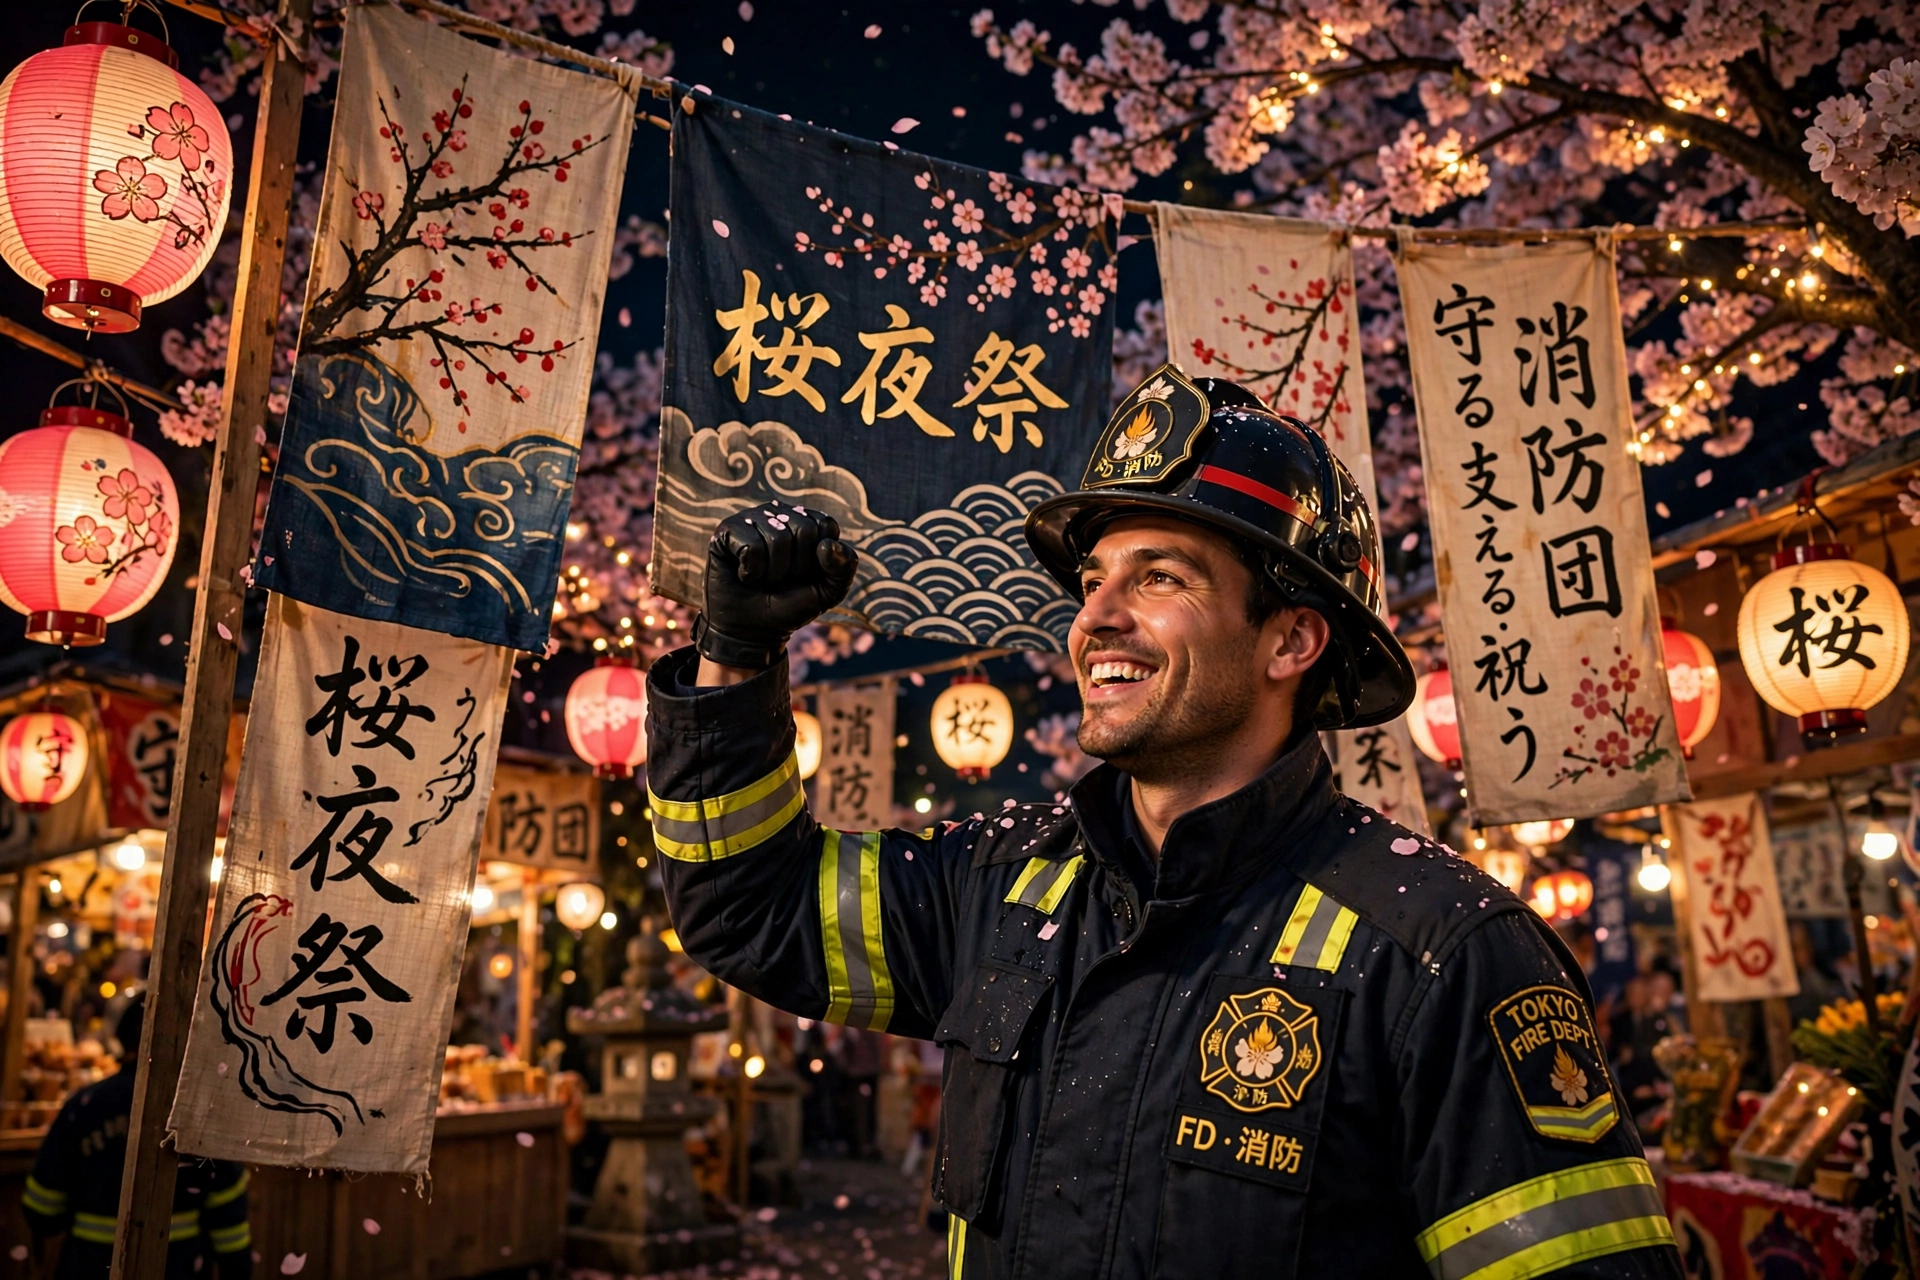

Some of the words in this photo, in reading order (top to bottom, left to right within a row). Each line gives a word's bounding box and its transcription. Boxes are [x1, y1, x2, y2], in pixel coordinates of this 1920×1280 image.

[714, 269, 1070, 454] 桜夜祭
[1515, 301, 1623, 619] 消防団
[1773, 584, 1884, 678] 桜
[944, 698, 997, 746] 桜
[260, 635, 436, 1055] 桜夜祭
[485, 790, 589, 862] 防団
[1505, 994, 1579, 1028] TOKYO
[1510, 1022, 1551, 1061] FIRE
[1550, 1020, 1590, 1049] DEPT
